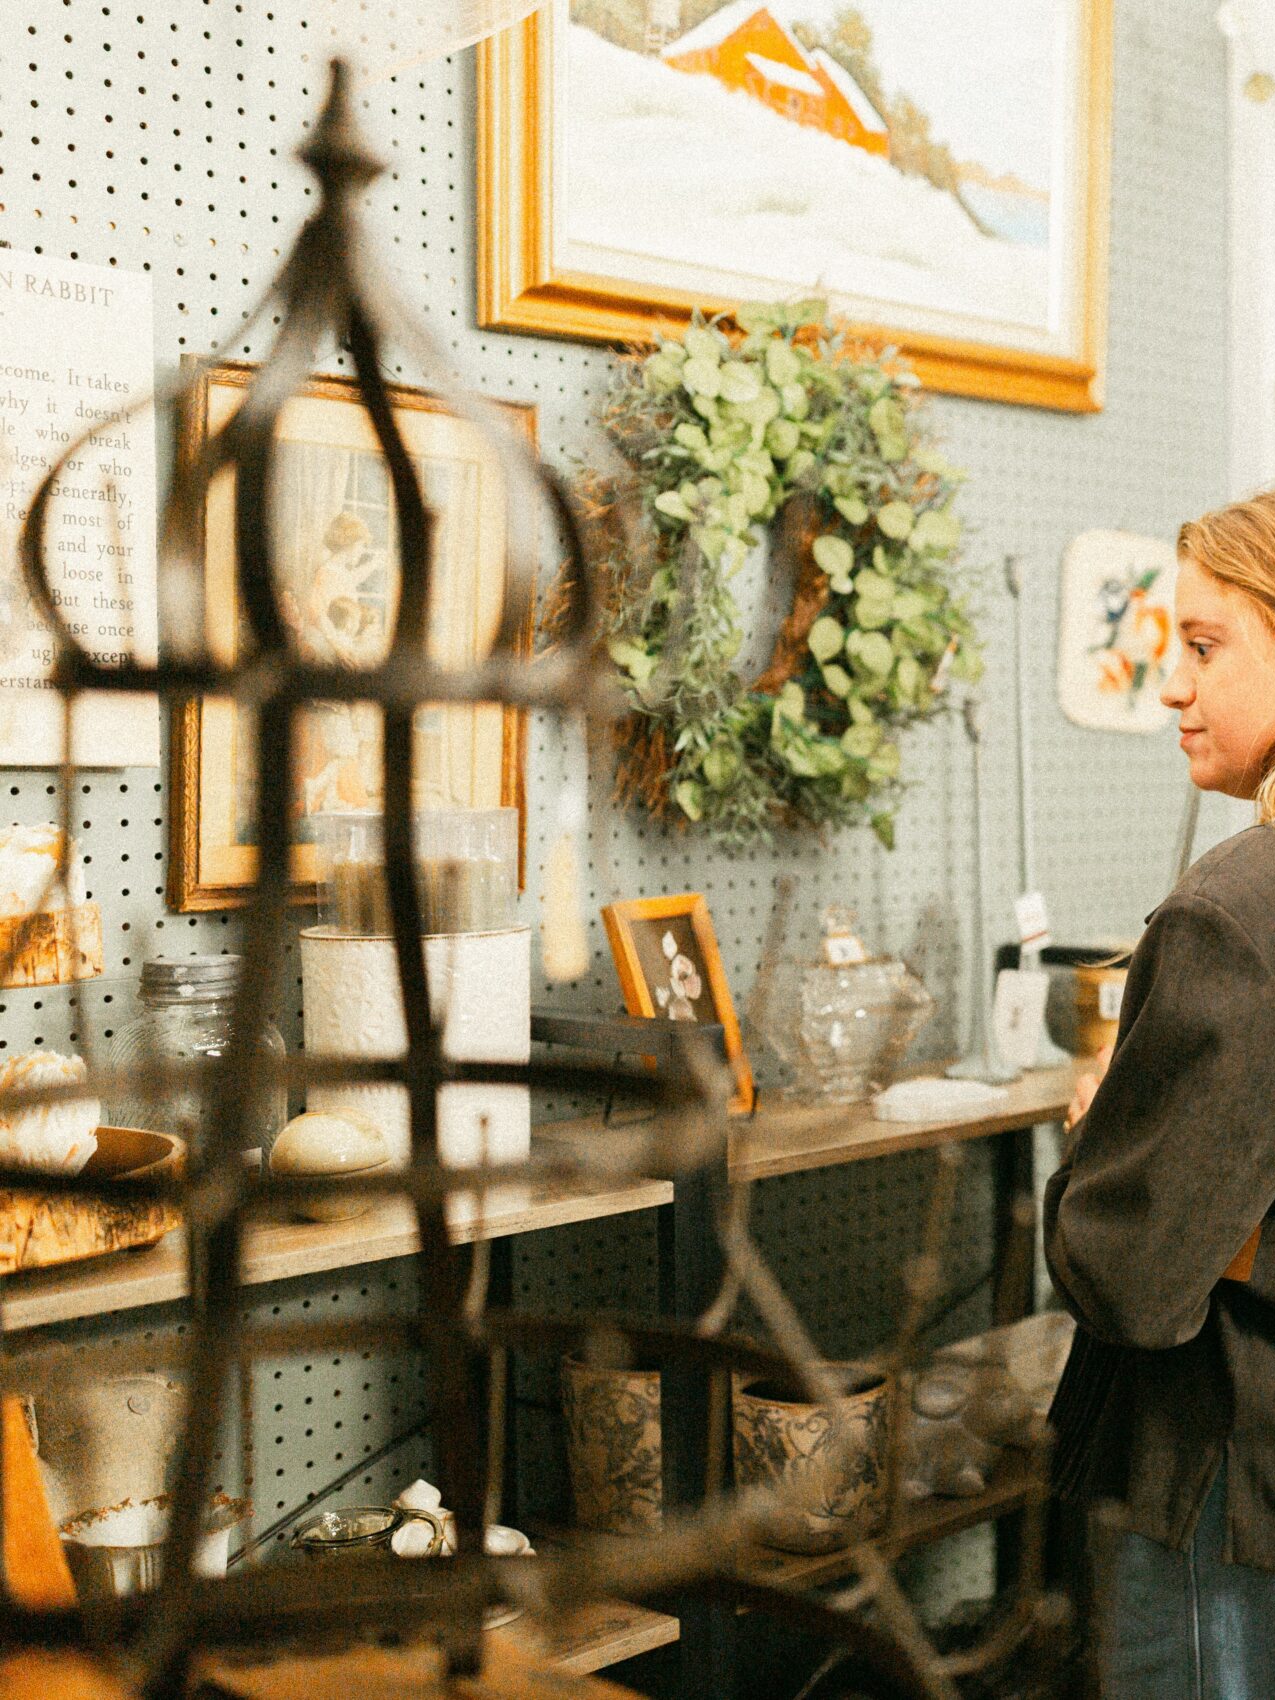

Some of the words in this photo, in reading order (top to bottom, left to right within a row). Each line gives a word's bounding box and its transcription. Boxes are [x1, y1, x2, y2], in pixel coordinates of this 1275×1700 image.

[25, 273, 114, 307] RABBIT
[68, 368, 81, 387] It
[87, 373, 130, 394] takes
[47, 397, 57, 414] it
[74, 400, 132, 424] doesn't
[36, 423, 70, 443] who
[88, 428, 131, 450] break
[67, 459, 84, 471] or
[99, 458, 132, 476] who
[49, 480, 132, 509] Generally,
[62, 513, 103, 528] most
[117, 513, 134, 530] of
[57, 536, 87, 554] and
[97, 544, 134, 560] your
[62, 562, 103, 582] loose
[118, 566, 134, 585] in
[52, 589, 80, 608] But
[93, 592, 134, 611] these
[98, 624, 135, 638] once
